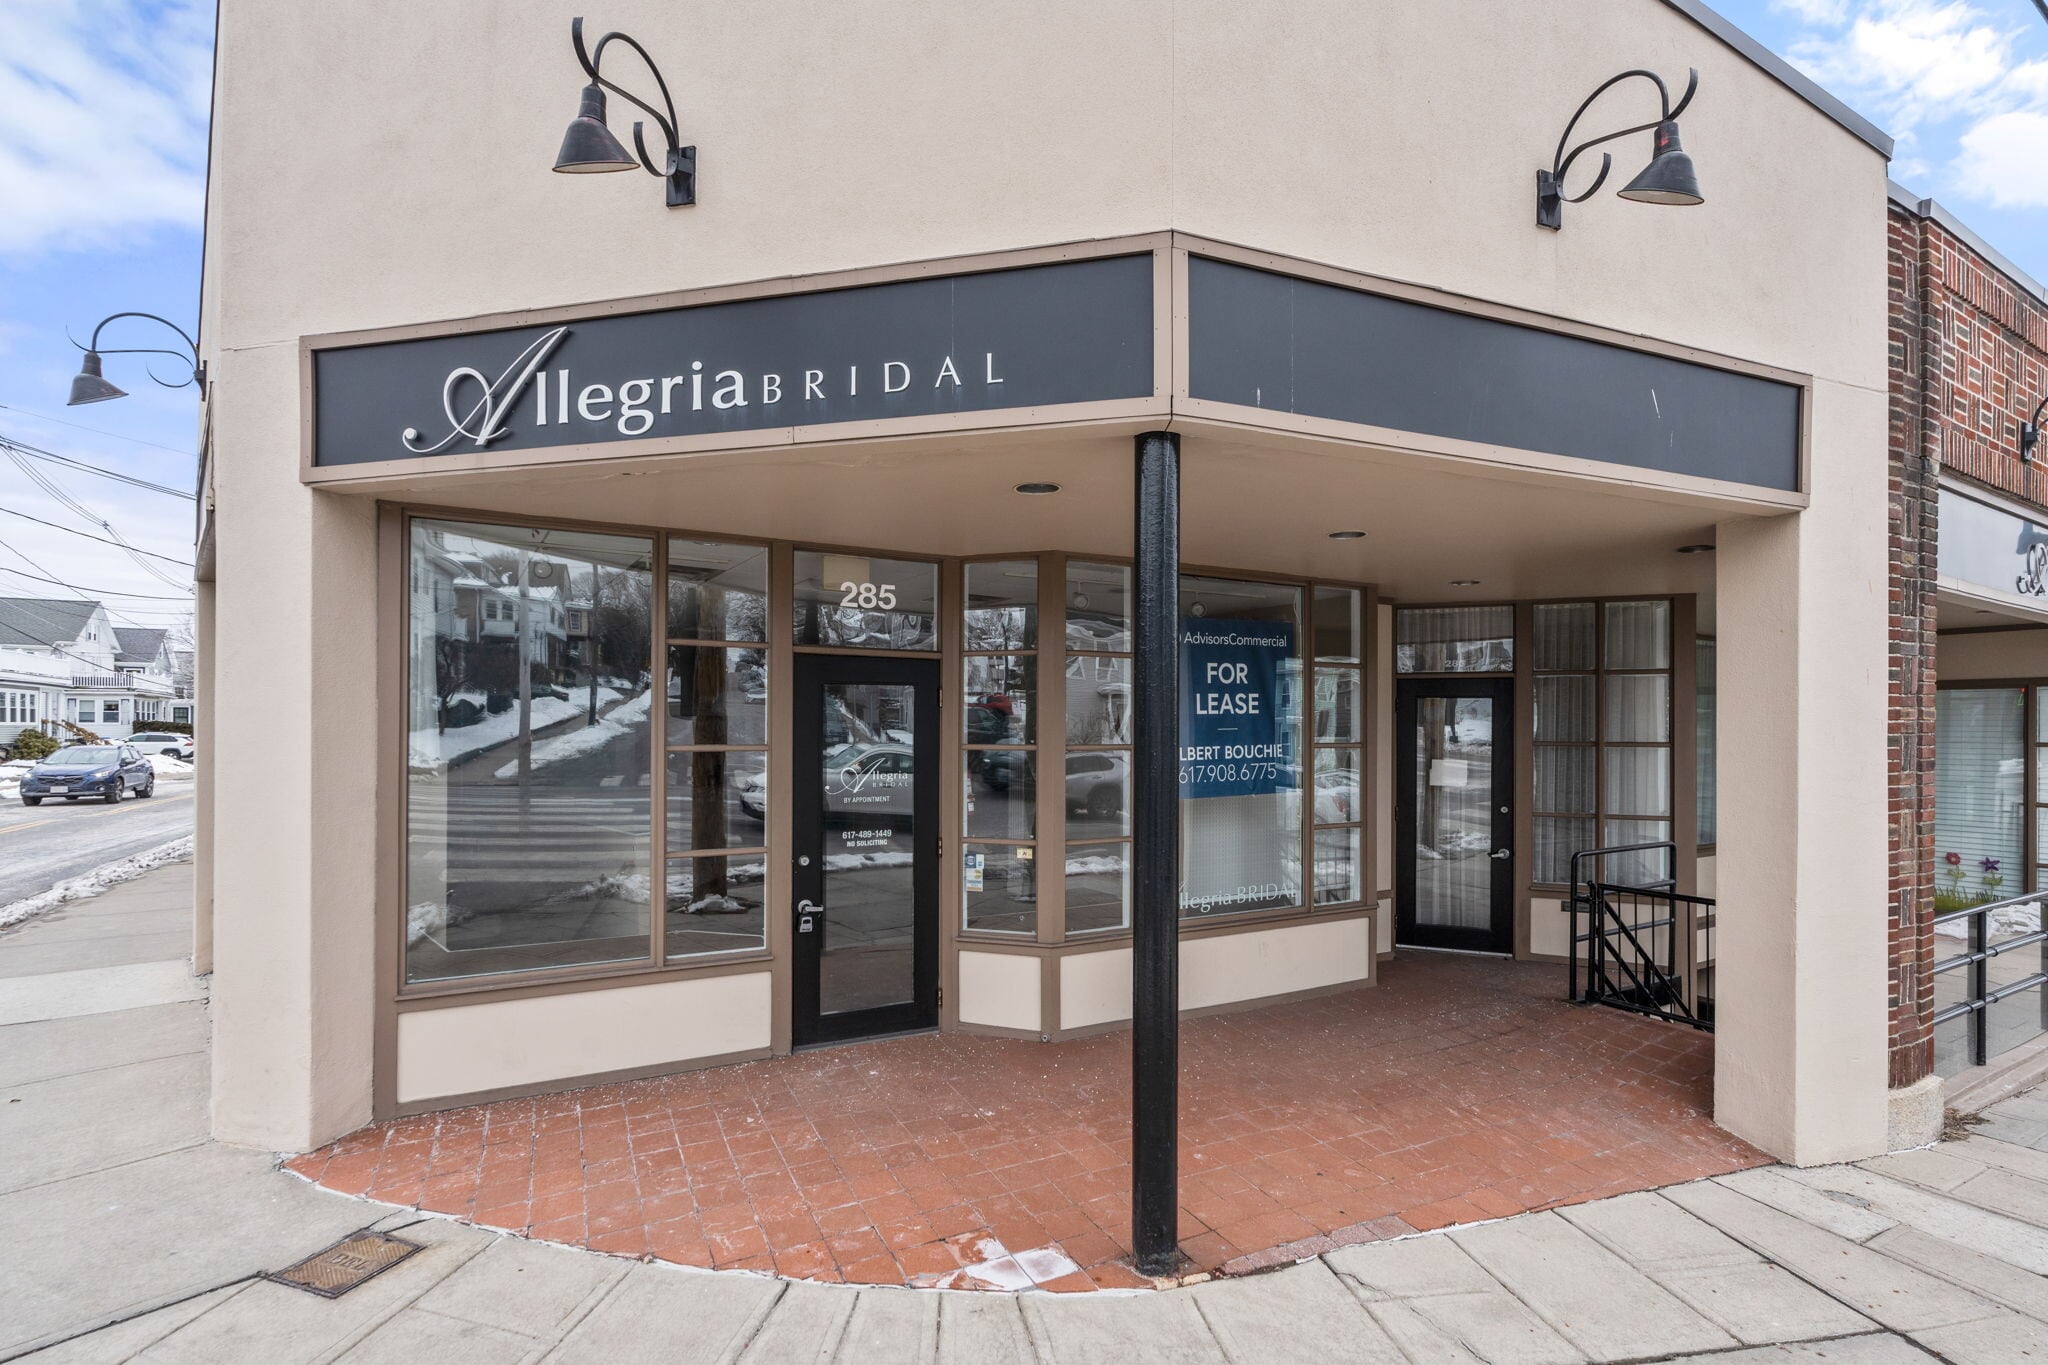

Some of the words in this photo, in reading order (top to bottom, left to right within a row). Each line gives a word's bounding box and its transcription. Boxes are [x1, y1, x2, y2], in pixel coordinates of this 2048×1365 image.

[402, 326, 749, 453] Allegria
[762, 351, 1004, 405] BRIDAL
[840, 581, 897, 610] 285
[1184, 631, 1287, 647] AdvisorsCommercial
[1207, 662, 1249, 684] FOR
[1196, 693, 1260, 715] LEASE
[1179, 745, 1220, 761] LBERT
[1224, 743, 1283, 759] BOUCHIE
[825, 757, 908, 795] Allegria
[1179, 762, 1277, 784] 617.908.6775
[842, 829, 892, 839] 617-489-1449
[856, 839, 888, 847] SOLICITING
[1179, 882, 1232, 912] llegria
